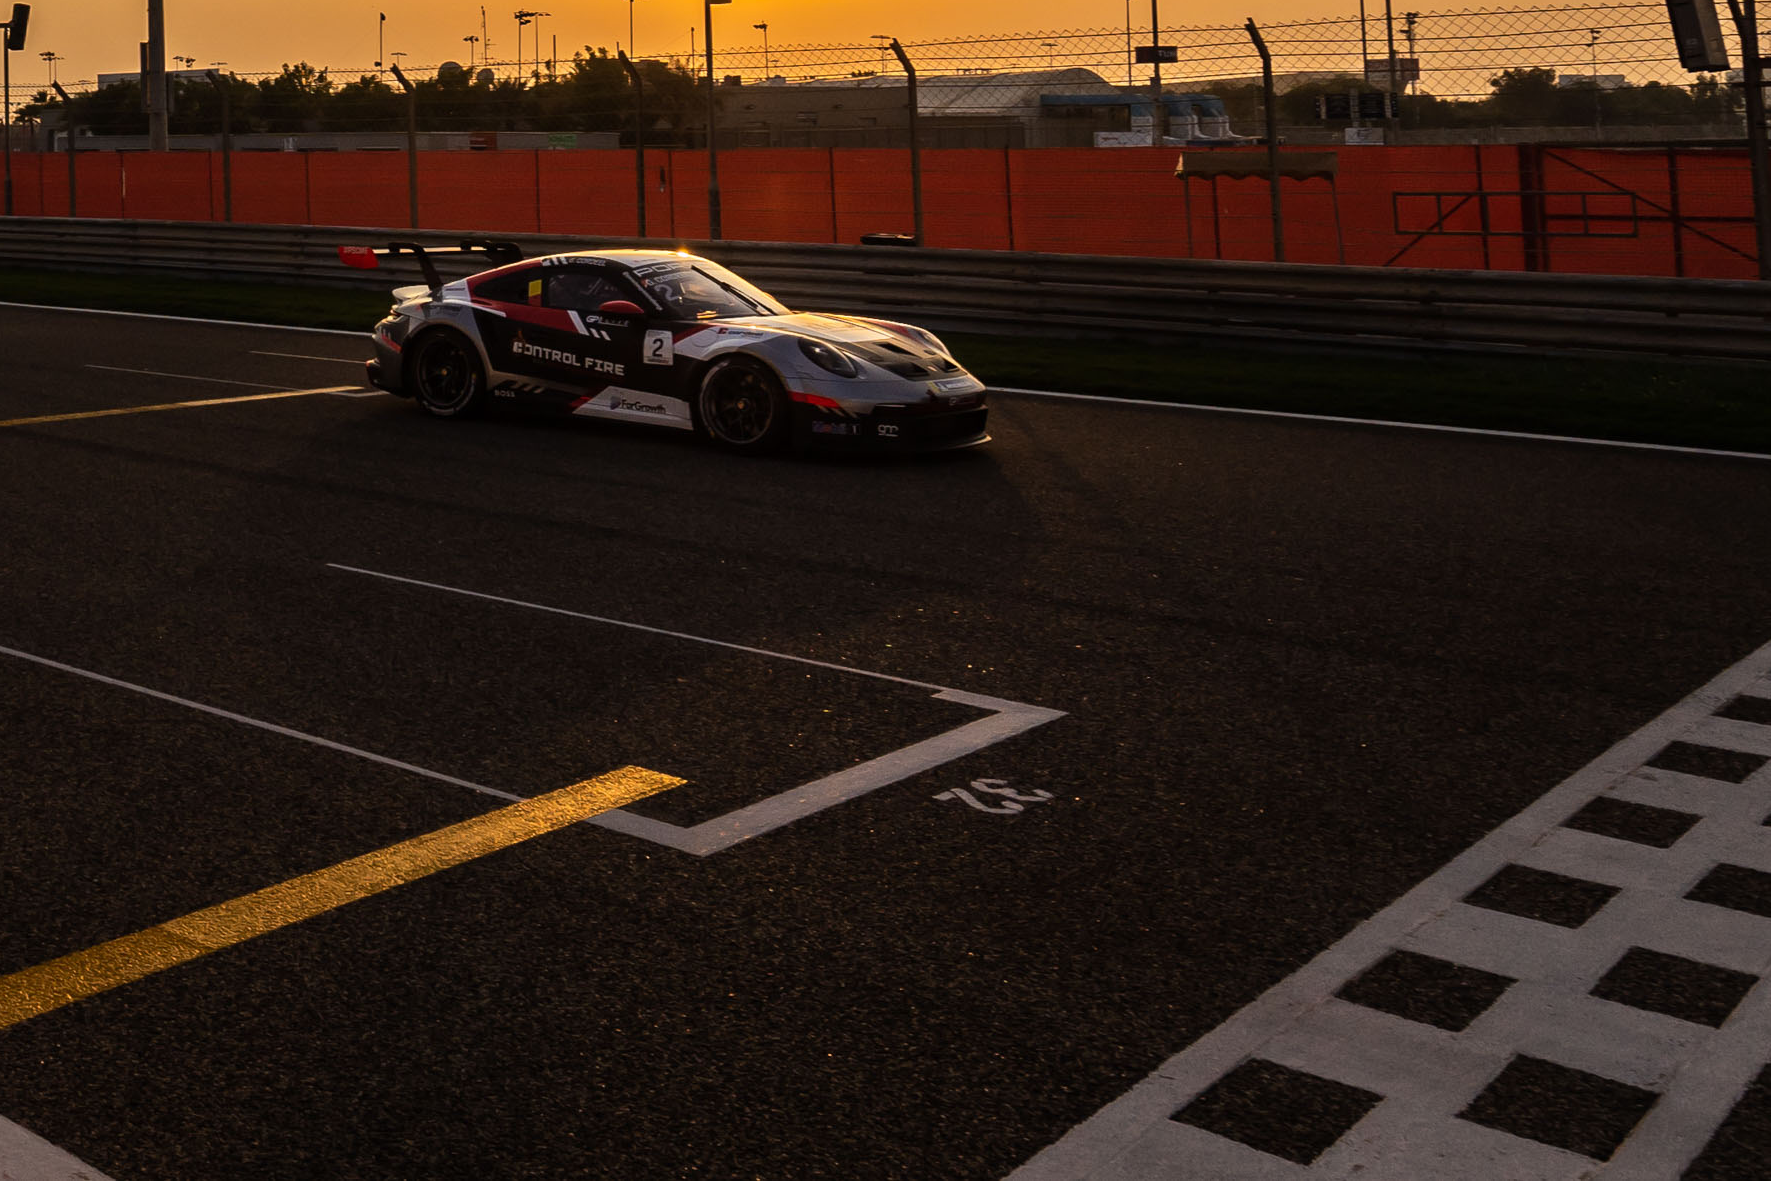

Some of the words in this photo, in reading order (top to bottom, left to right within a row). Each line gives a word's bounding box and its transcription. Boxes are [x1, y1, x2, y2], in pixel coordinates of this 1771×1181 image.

[512, 341, 581, 367] CONTROL
[584, 357, 625, 376] FIRE
[652, 338, 664, 357] 2
